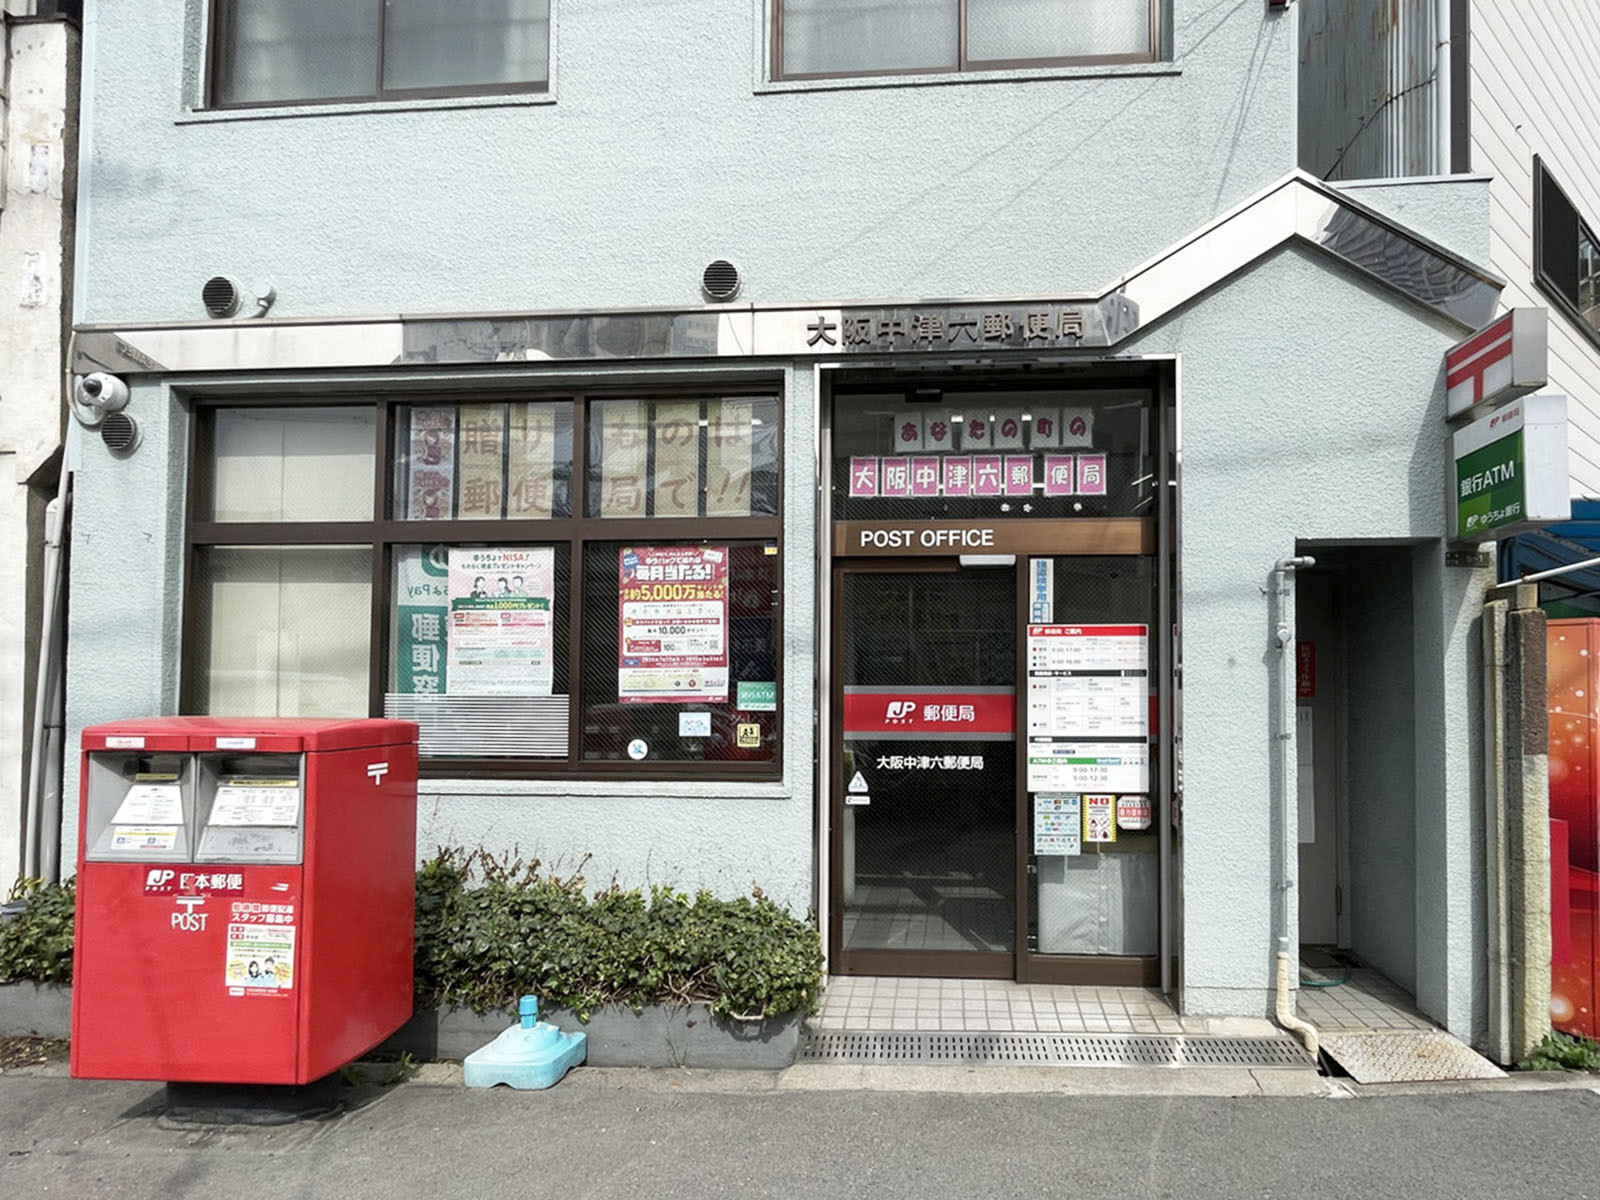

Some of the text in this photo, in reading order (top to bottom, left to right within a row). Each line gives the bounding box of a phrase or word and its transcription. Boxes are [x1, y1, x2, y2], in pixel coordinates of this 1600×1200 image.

[806, 308, 1086, 347] 大阪中津六郵便局
[900, 415, 1087, 442] あなたの町の
[854, 463, 1101, 490] 大阪中津六郵便局
[1460, 460, 1515, 498] 銀行ATM
[1480, 502, 1521, 525] ゆうちょ銀行
[860, 528, 995, 548] POST OFFICE
[923, 704, 976, 723] 郵便局
[876, 755, 984, 771] 大阪中津六郵便局
[170, 912, 209, 931] POST
